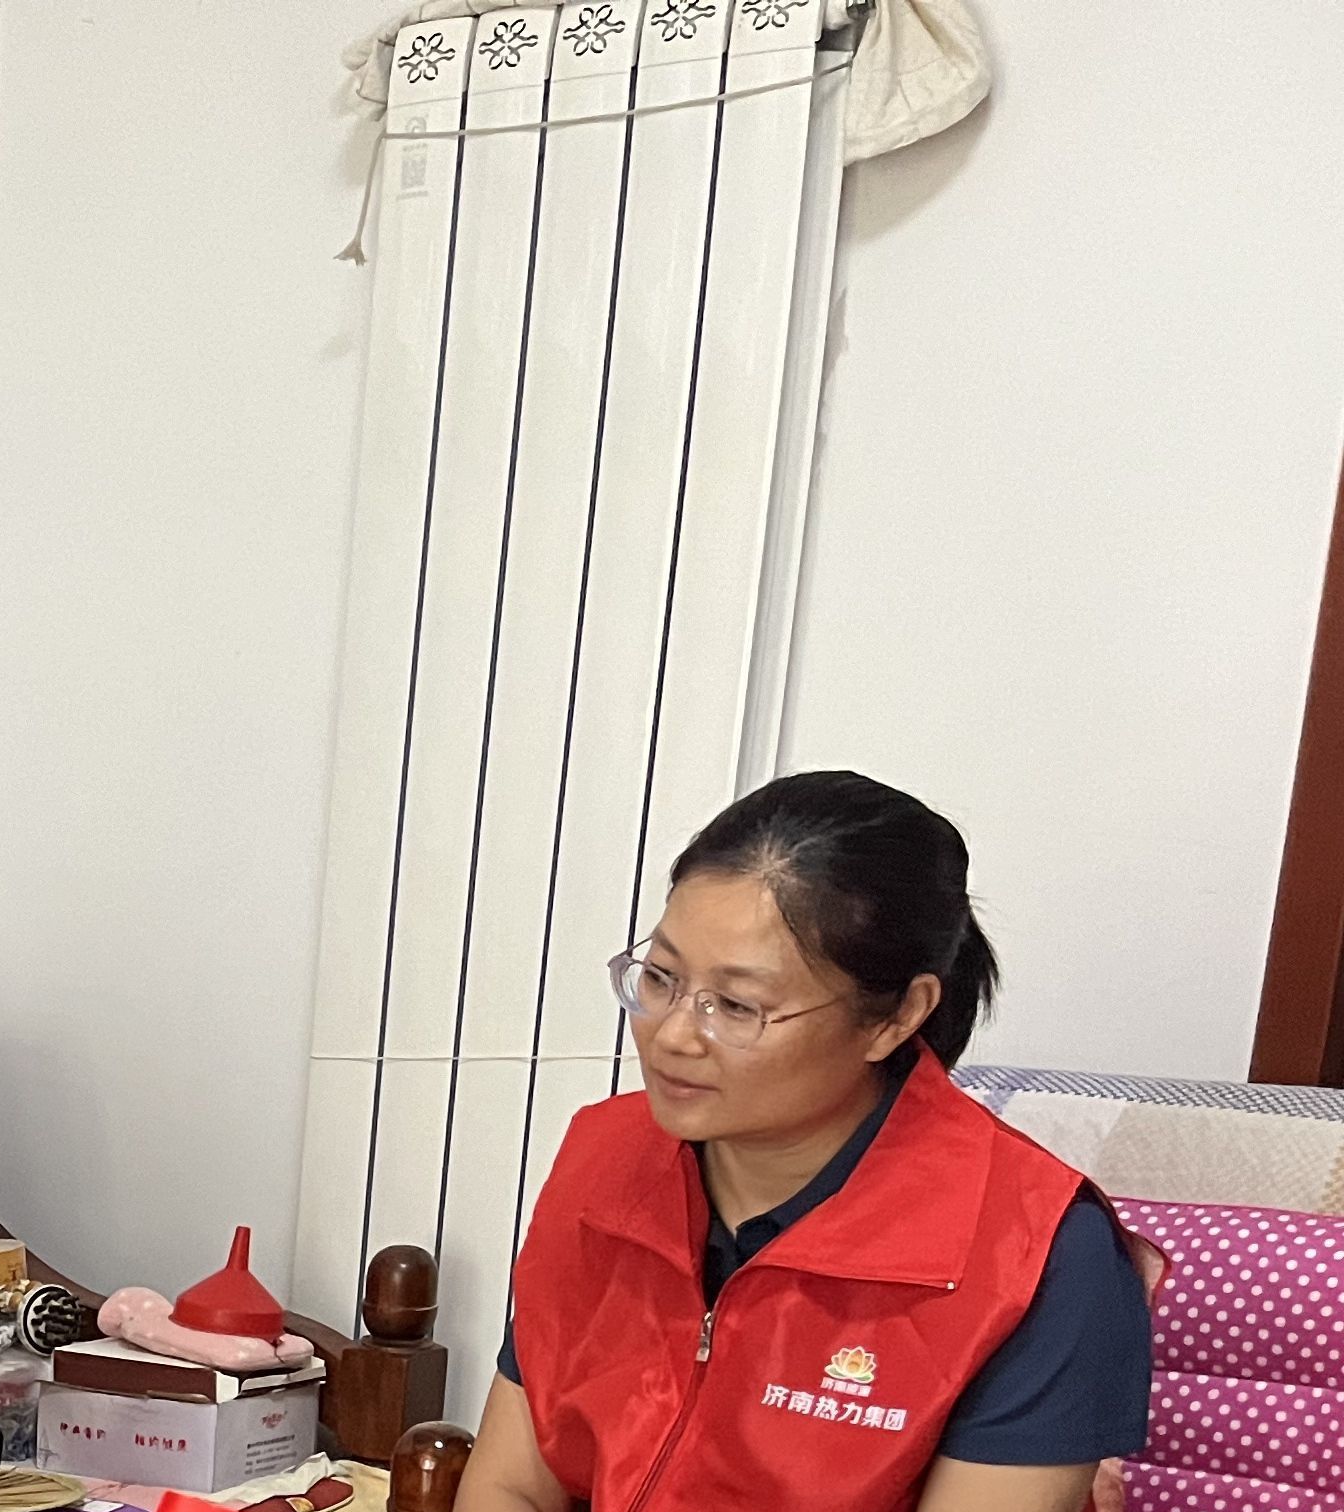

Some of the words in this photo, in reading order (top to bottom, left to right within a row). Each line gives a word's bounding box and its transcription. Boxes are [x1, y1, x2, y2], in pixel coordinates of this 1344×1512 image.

[761, 1383, 908, 1431] 济南热力集团
